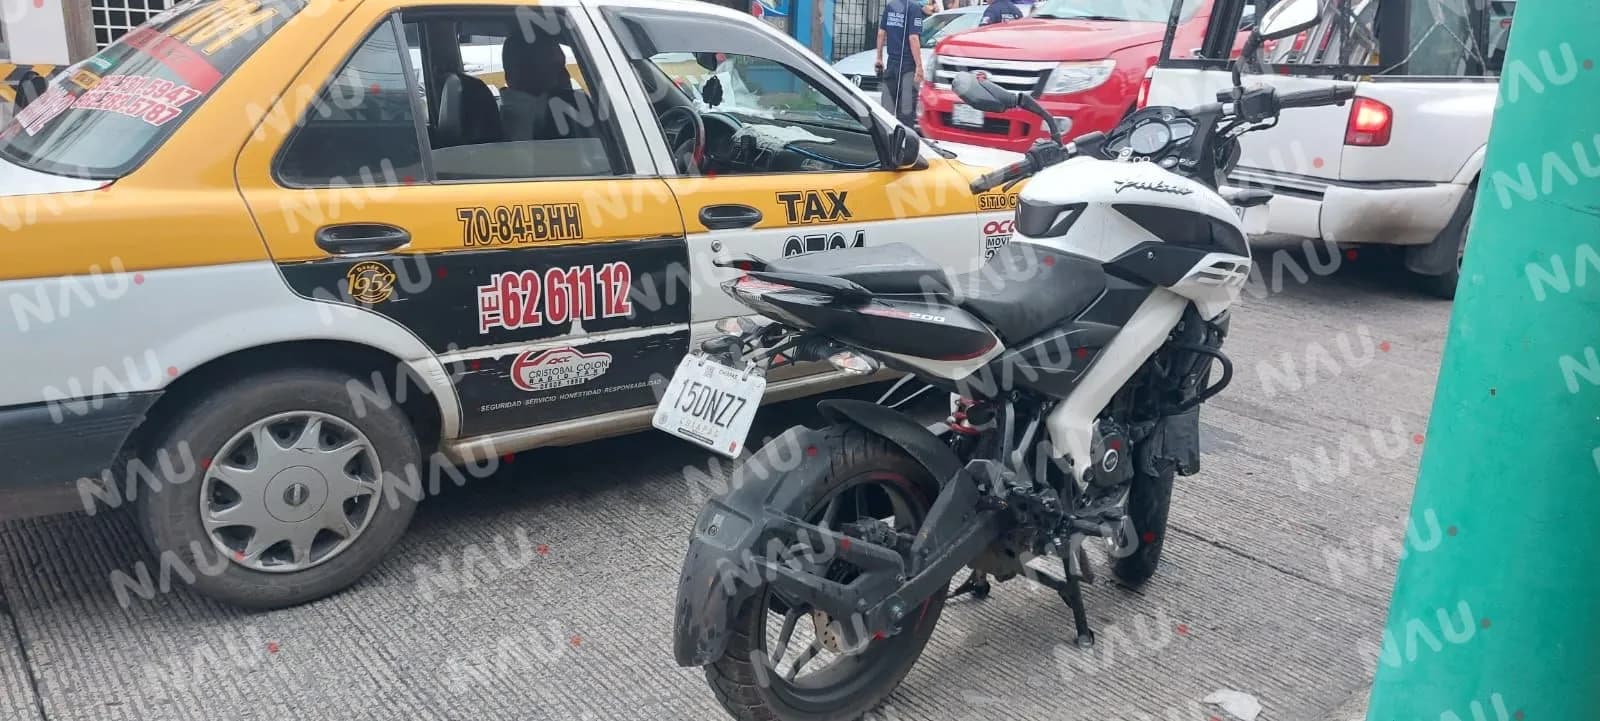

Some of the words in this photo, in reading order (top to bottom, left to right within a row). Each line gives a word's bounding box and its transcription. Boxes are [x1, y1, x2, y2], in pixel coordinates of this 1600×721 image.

[775, 189, 853, 224] TAX
[979, 195, 1006, 208] SITIO
[457, 203, 582, 246] 70-84-BHH
[347, 273, 396, 296] 1952
[478, 275, 500, 333] TEL
[501, 270, 542, 329] 62
[545, 266, 595, 324] 611
[597, 262, 632, 318] 12
[528, 366, 574, 378] CRISTOBAL
[576, 360, 608, 372] COLON
[480, 400, 521, 412] SEGURIDAD
[525, 395, 556, 405] SERVICIO
[559, 389, 601, 400] HONESTIDAD
[604, 379, 661, 393] RESPONSABILIDAD
[674, 379, 747, 429] 15DNZ7
